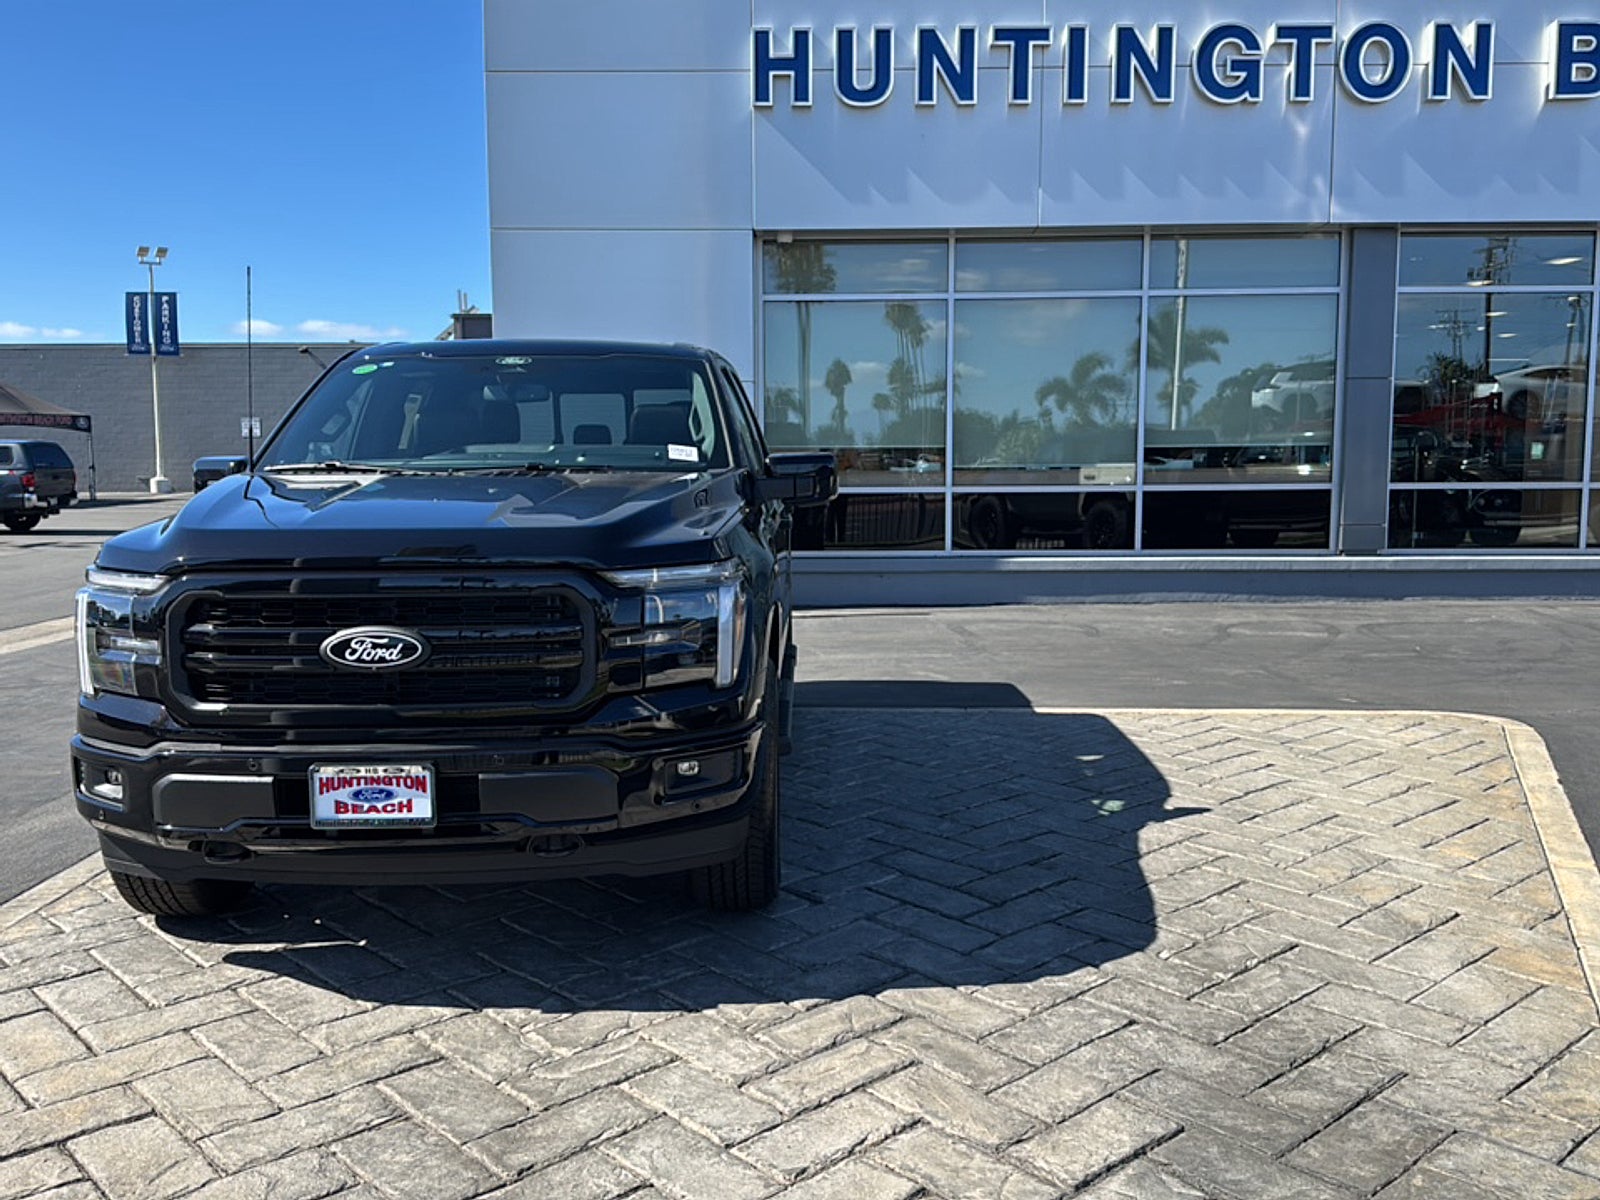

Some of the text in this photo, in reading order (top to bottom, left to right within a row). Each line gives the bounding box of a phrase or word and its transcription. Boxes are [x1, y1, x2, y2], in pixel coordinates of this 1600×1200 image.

[752, 21, 1495, 107] HUNTINGTON
[161, 295, 171, 345] PARKING
[344, 636, 403, 661] Ford
[319, 775, 428, 796] HUNTINGTON
[359, 790, 387, 800] Ford
[334, 799, 414, 815] BEACH
